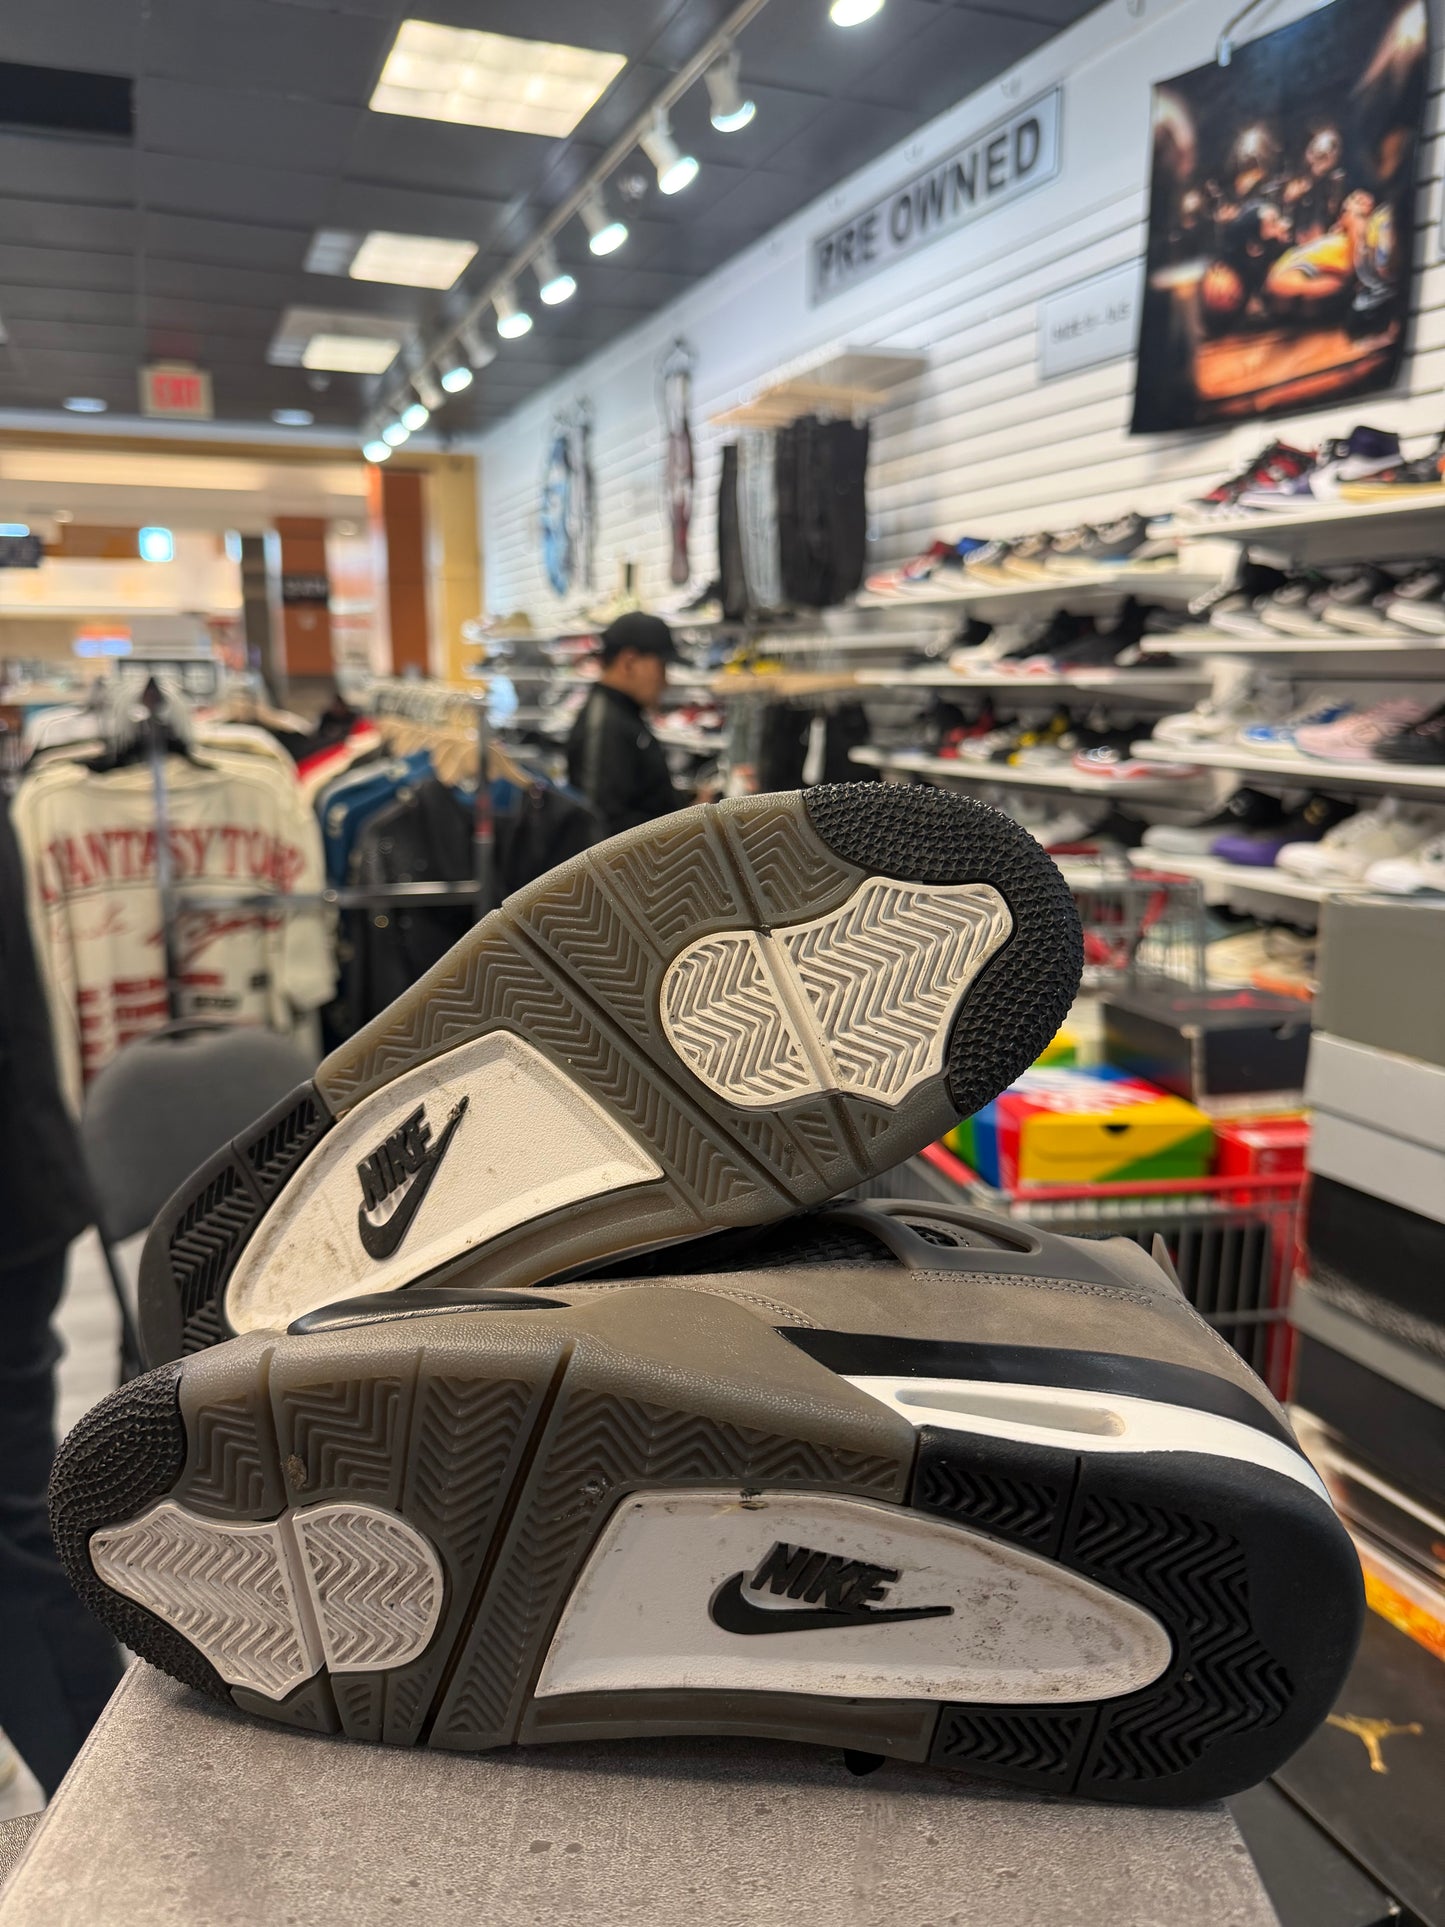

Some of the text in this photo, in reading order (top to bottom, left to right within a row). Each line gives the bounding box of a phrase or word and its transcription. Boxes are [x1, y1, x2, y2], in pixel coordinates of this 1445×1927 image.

[819, 116, 1041, 284] PRE OWNED
[356, 1102, 436, 1212] NIKE
[750, 1541, 903, 1611] NIKE
